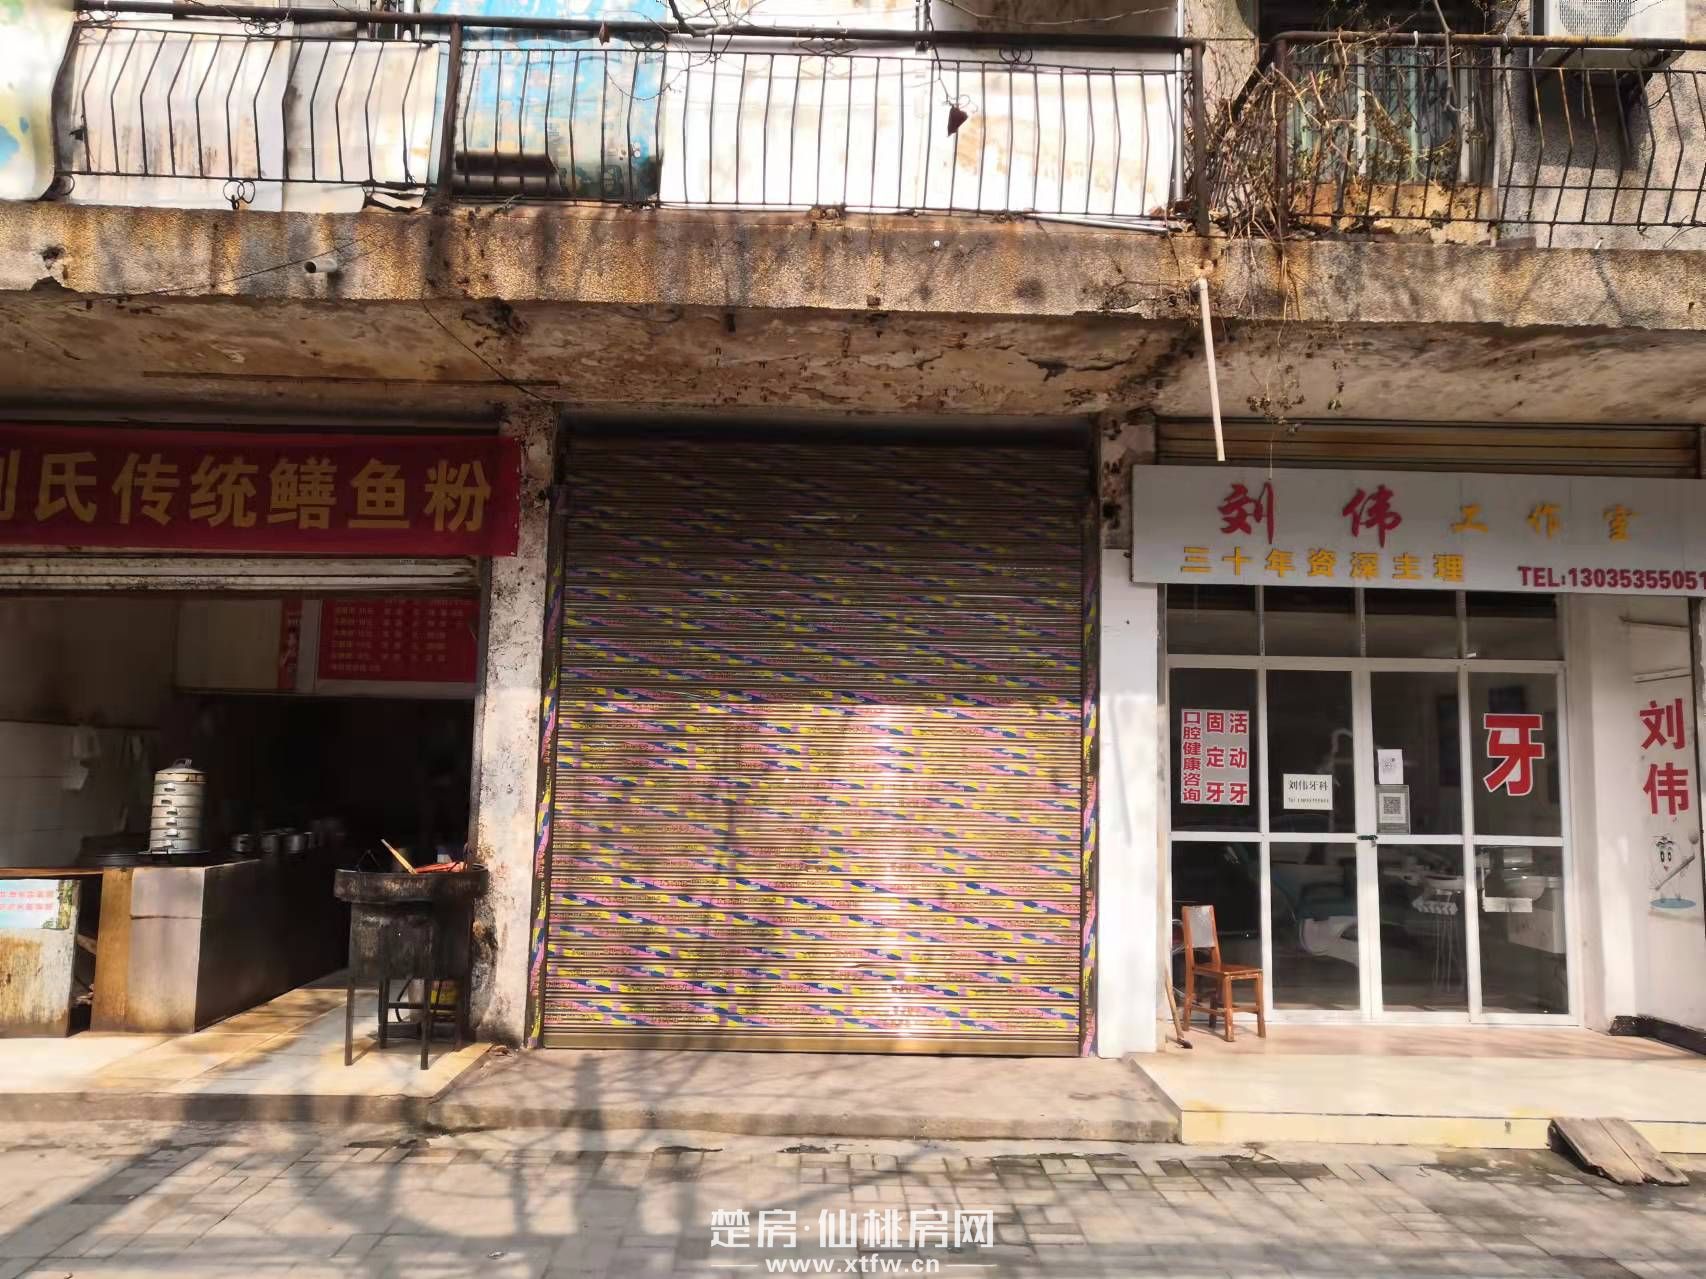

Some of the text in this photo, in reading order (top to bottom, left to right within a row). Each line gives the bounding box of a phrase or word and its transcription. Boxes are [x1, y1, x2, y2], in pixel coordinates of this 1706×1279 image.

[1217, 482, 1639, 548] 刘伟 工作室
[1180, 546, 1466, 583] 三十年资深主理
[1183, 711, 1201, 802] 口腔健康咨询
[1206, 712, 1225, 803] 固定牙
[1229, 712, 1248, 803] 活动牙
[1484, 713, 1544, 796] 牙
[1639, 698, 1689, 815] 刘伟
